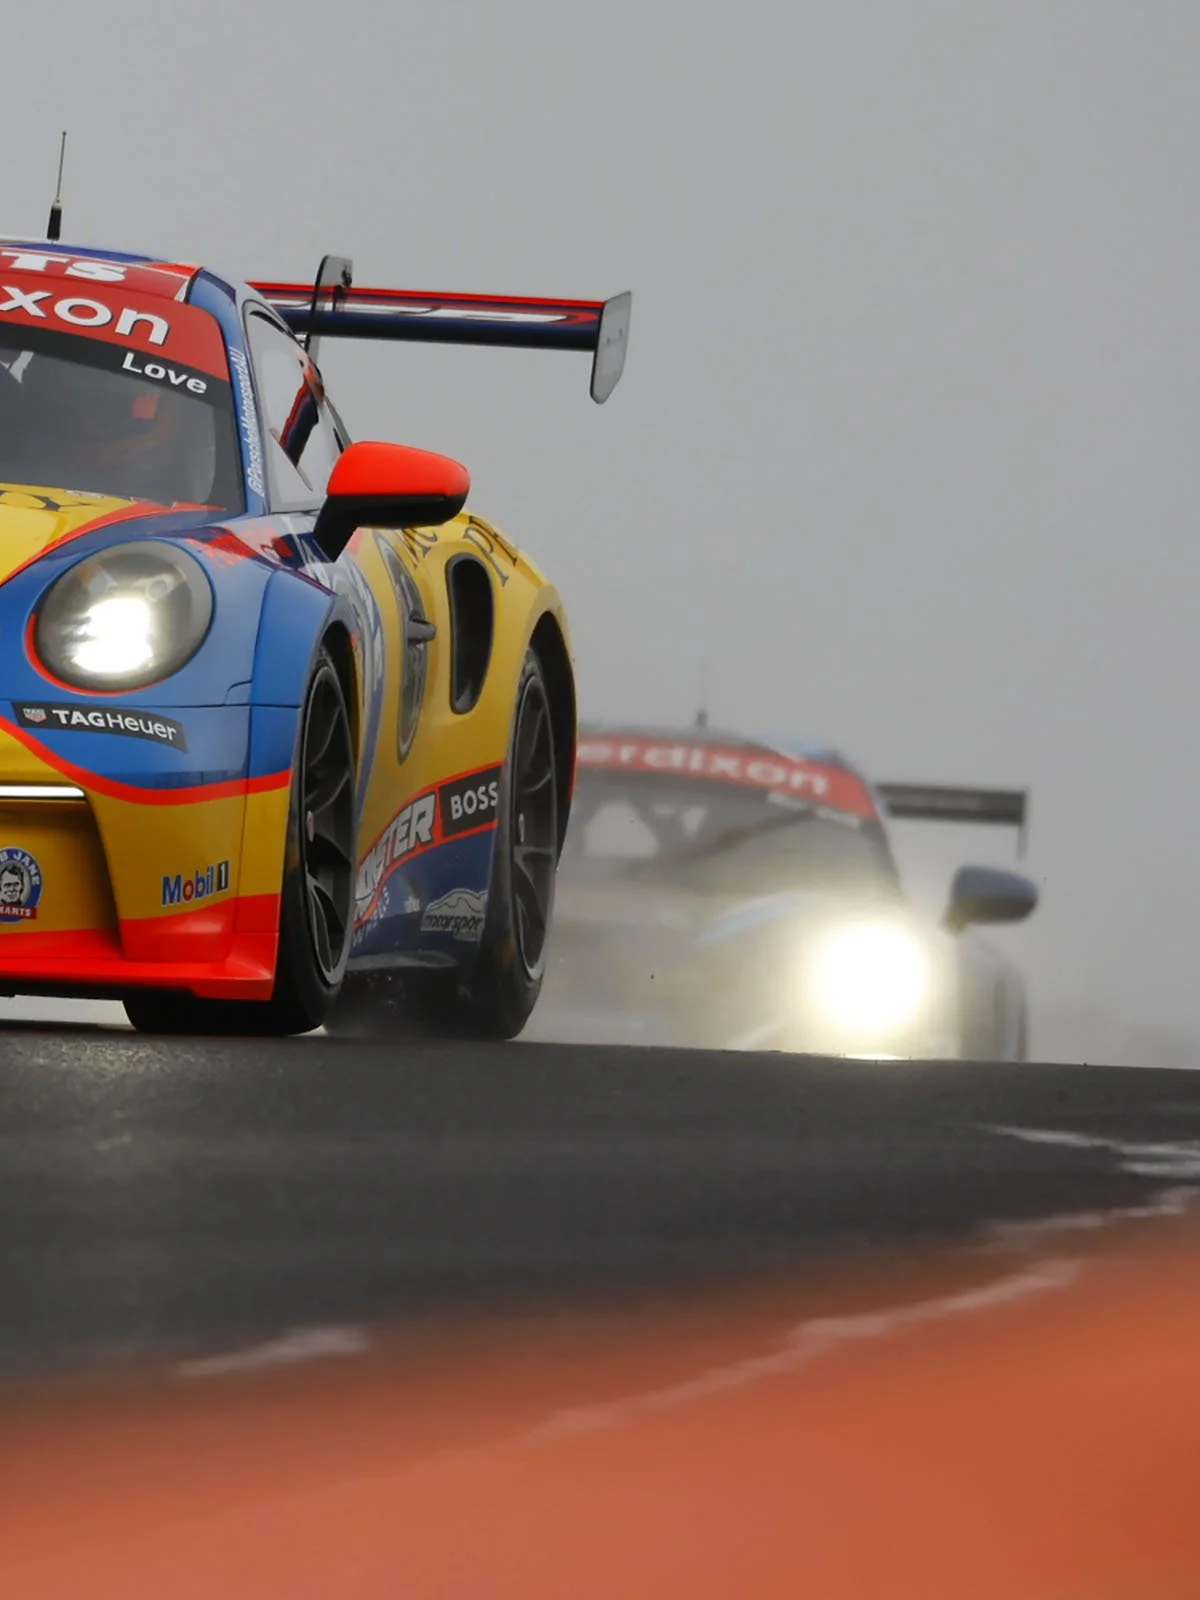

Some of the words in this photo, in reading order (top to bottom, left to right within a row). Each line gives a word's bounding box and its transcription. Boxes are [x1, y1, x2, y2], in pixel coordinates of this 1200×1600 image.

[122, 352, 208, 395] Love
[450, 781, 498, 821] BOSS
[13, 851, 41, 886] JANE
[161, 866, 214, 906] Mobil
